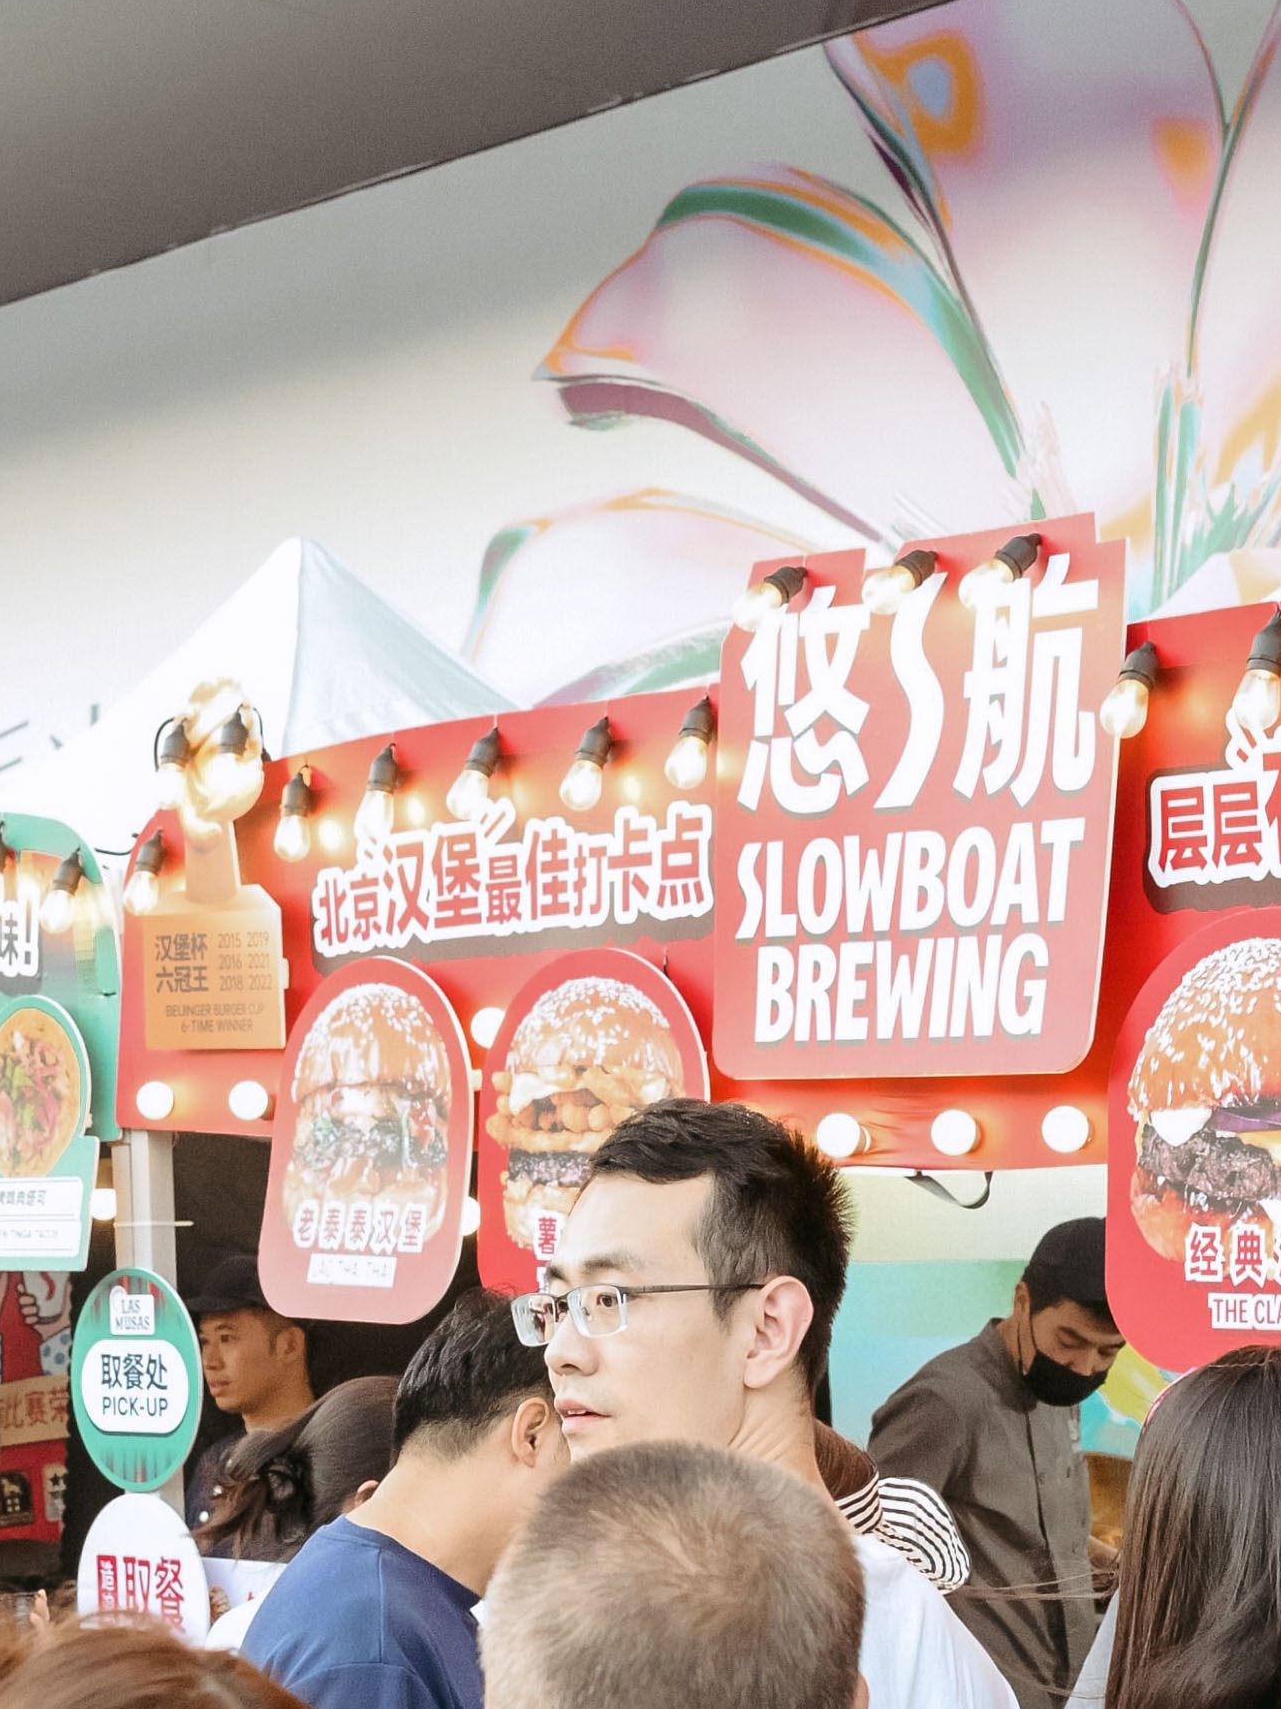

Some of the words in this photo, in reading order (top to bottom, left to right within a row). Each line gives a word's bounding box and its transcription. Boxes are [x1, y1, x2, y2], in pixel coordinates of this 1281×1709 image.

[318, 812, 706, 948] 北京汉堡最佳打卡点
[735, 817, 1085, 941] SLOWBOAT
[155, 933, 208, 961] 汉堡杯
[156, 966, 209, 993] 六冠王
[754, 934, 1049, 1043] BREWING
[120, 1299, 141, 1315] LAS
[1213, 1299, 1250, 1325] THE
[115, 1316, 152, 1332] MUSAS
[100, 1353, 169, 1392] 取餐处
[101, 1396, 169, 1418] PICK-UP
